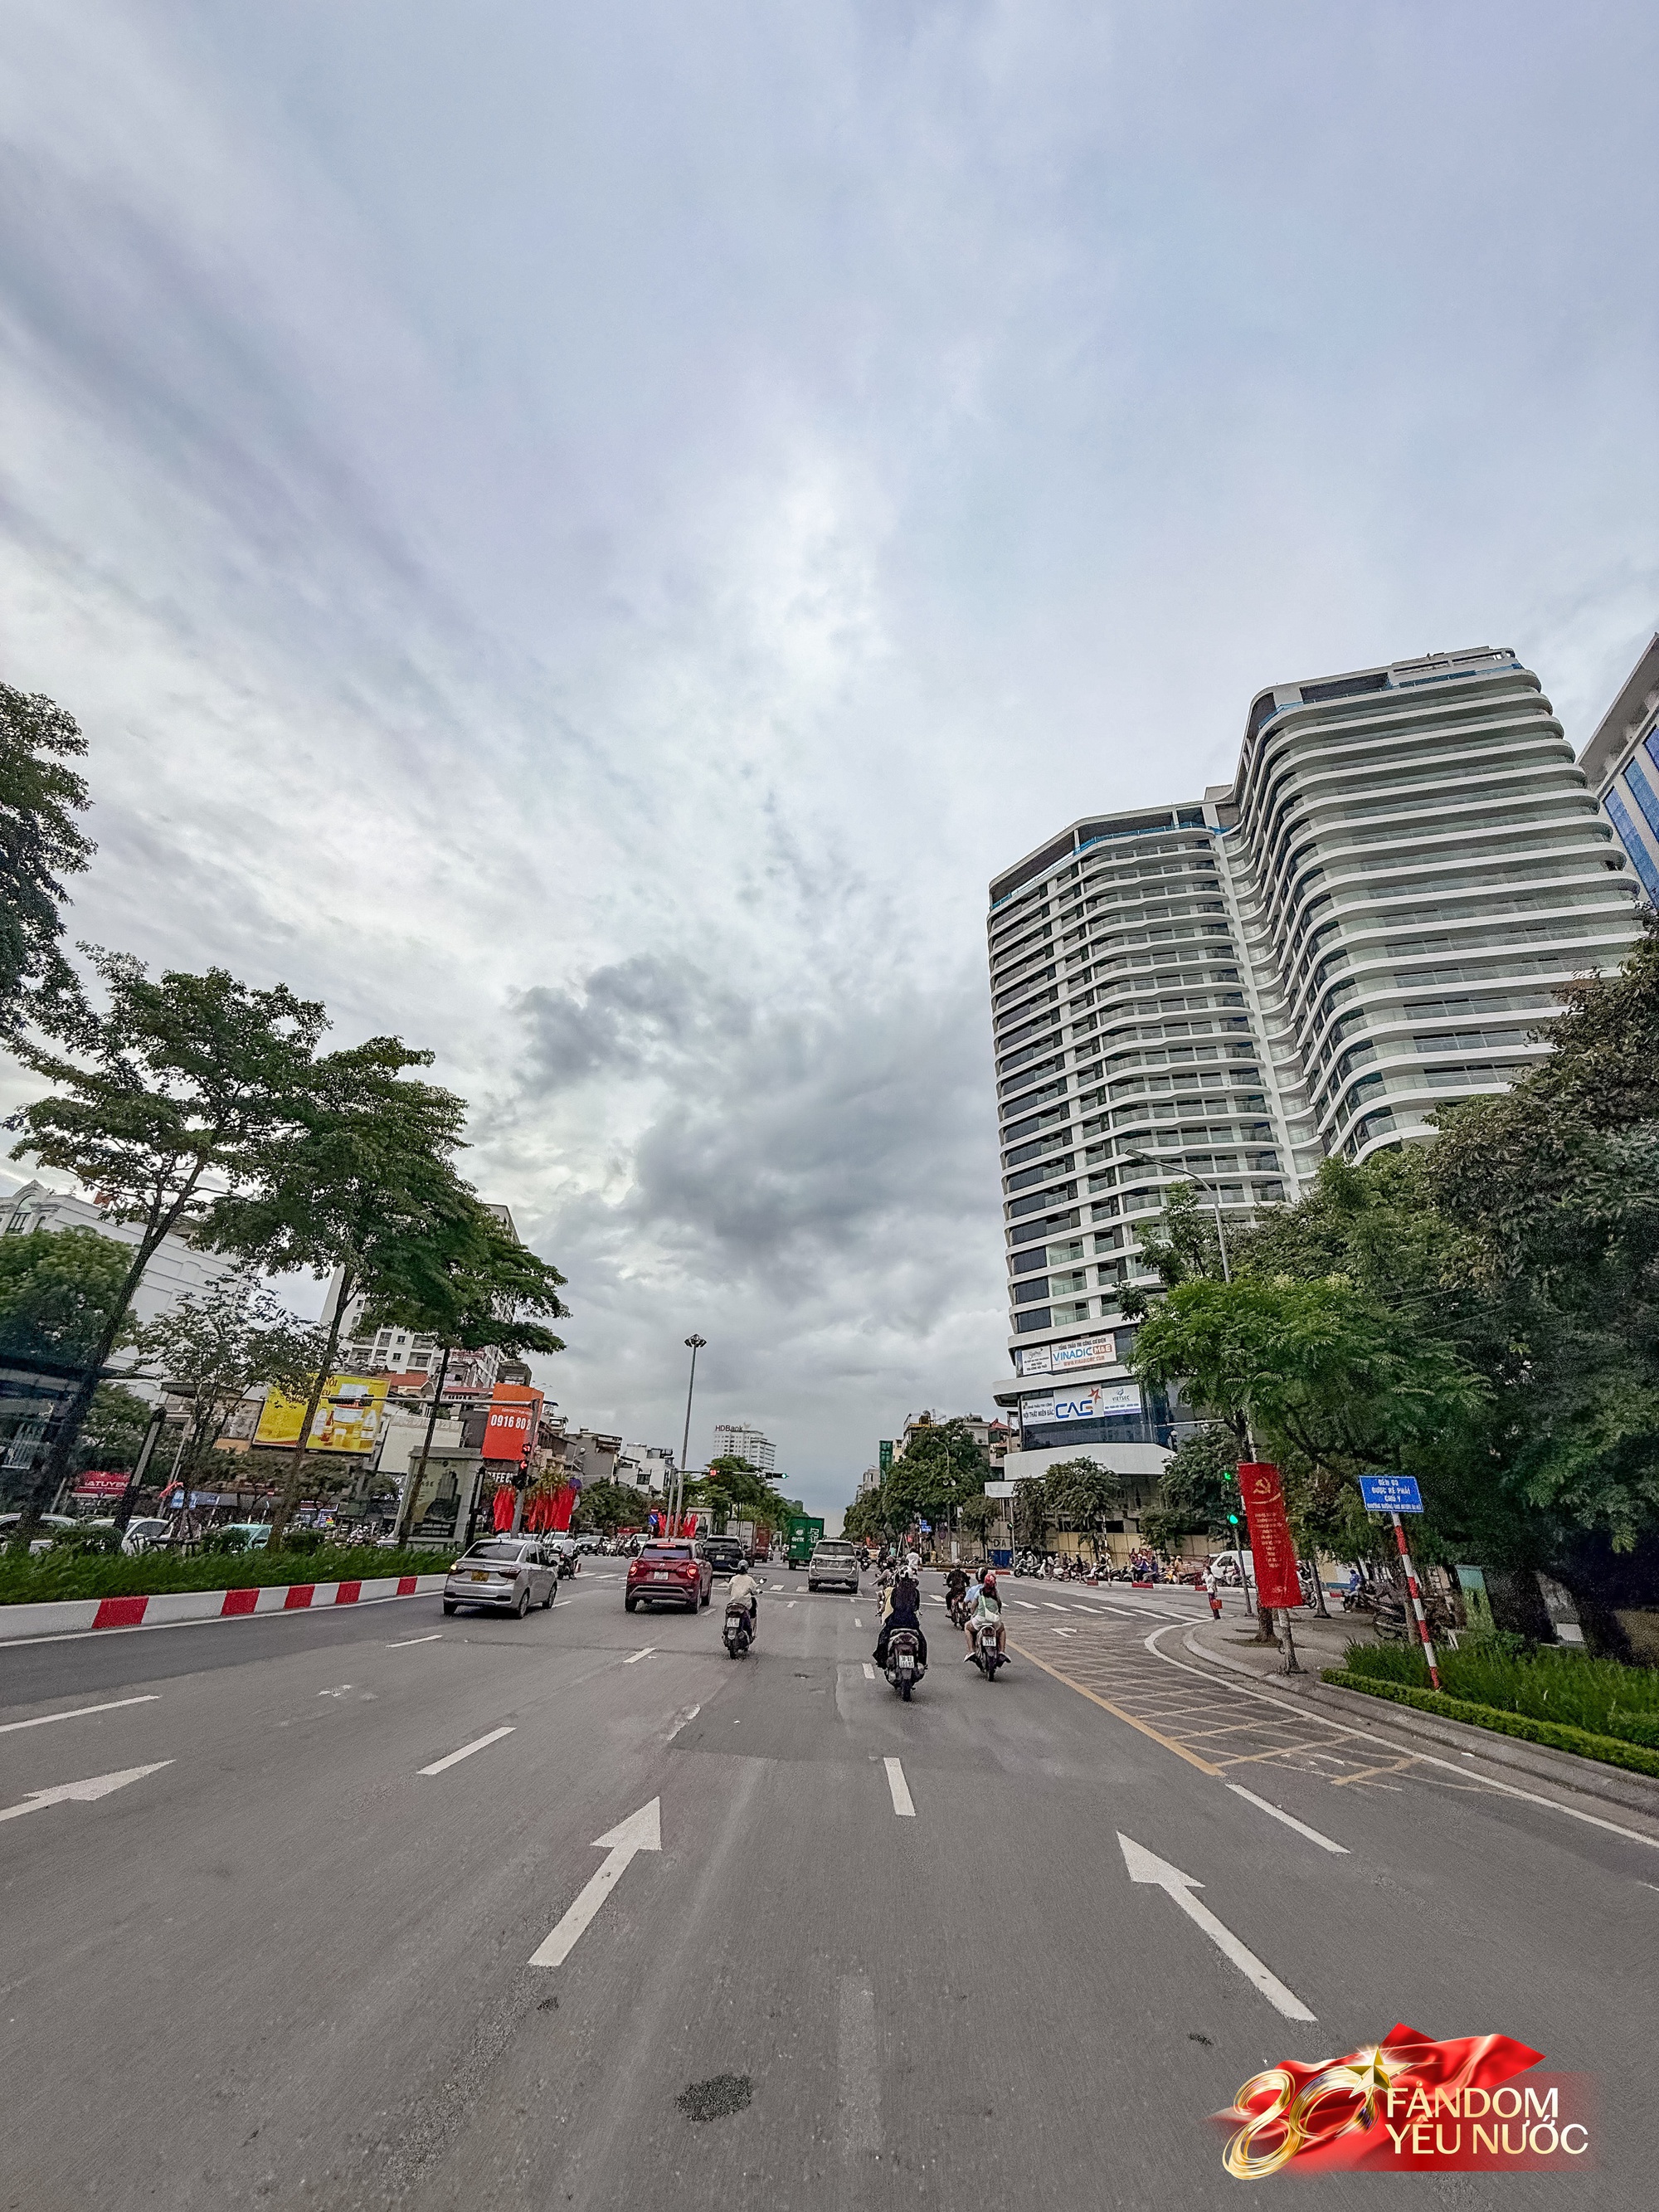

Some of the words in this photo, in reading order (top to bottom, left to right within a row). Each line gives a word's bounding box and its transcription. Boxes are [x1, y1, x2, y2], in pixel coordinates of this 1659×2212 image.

[1053, 1347, 1092, 1361] VINADIC
[1094, 1344, 1111, 1354] M&E
[491, 1415, 514, 1428] 0916
